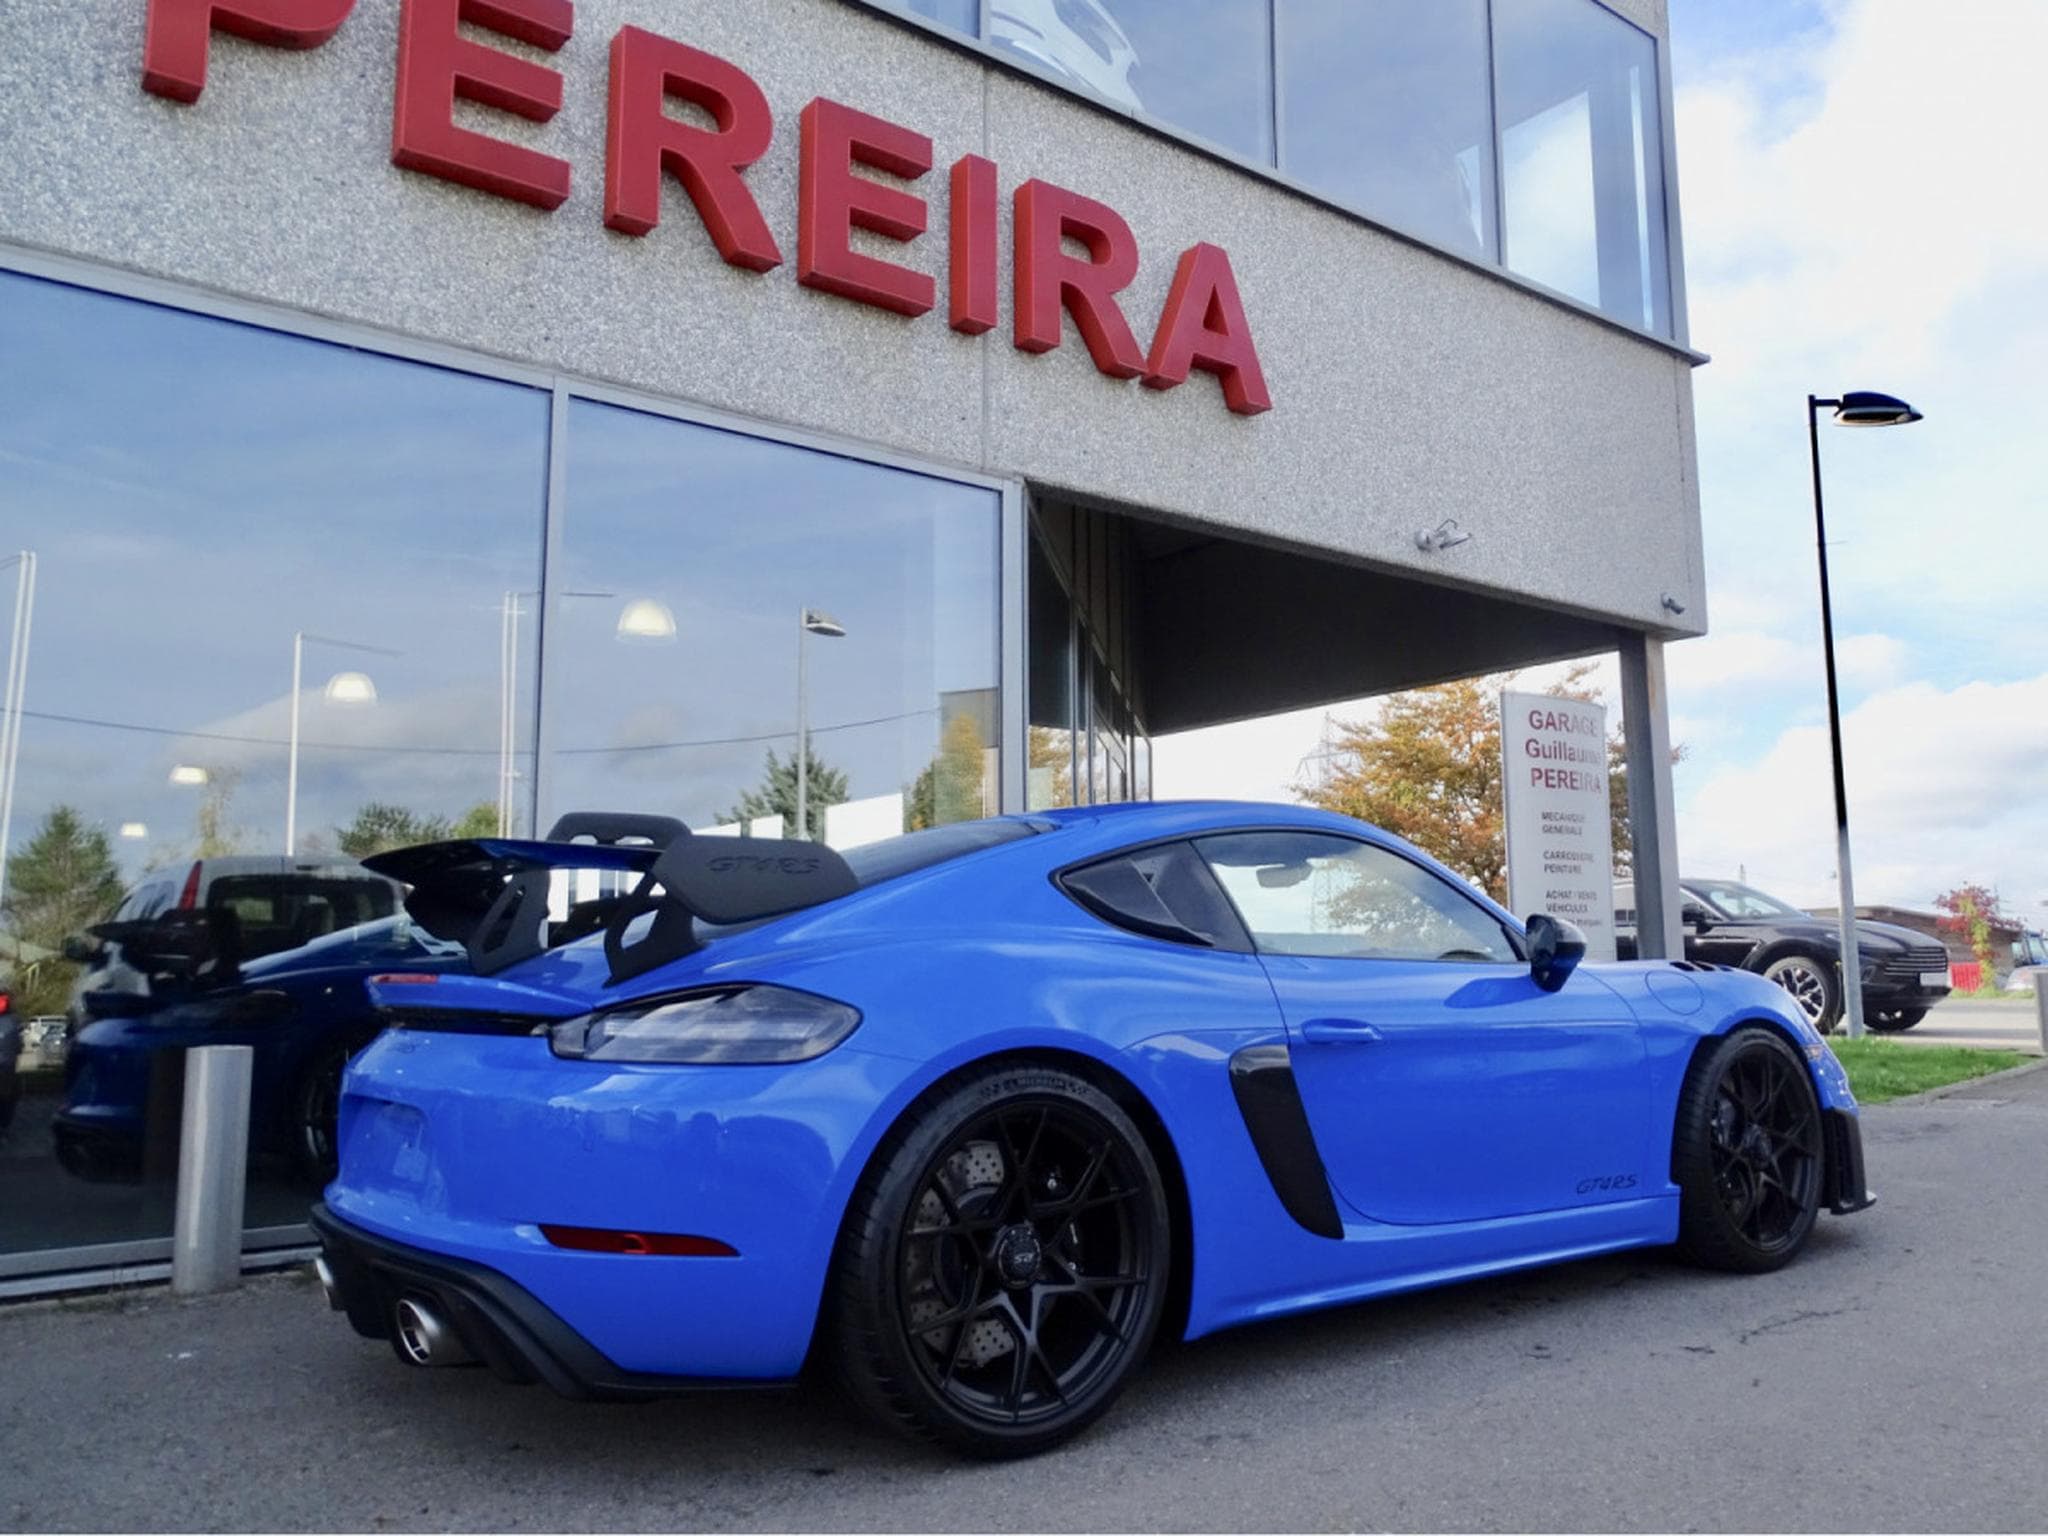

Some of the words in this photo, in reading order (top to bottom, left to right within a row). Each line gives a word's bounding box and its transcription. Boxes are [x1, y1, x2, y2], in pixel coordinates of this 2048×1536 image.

[1528, 709, 1598, 737] GARAGE
[1525, 738, 1601, 764] Guillaum
[1530, 767, 1602, 794] PEREIRA
